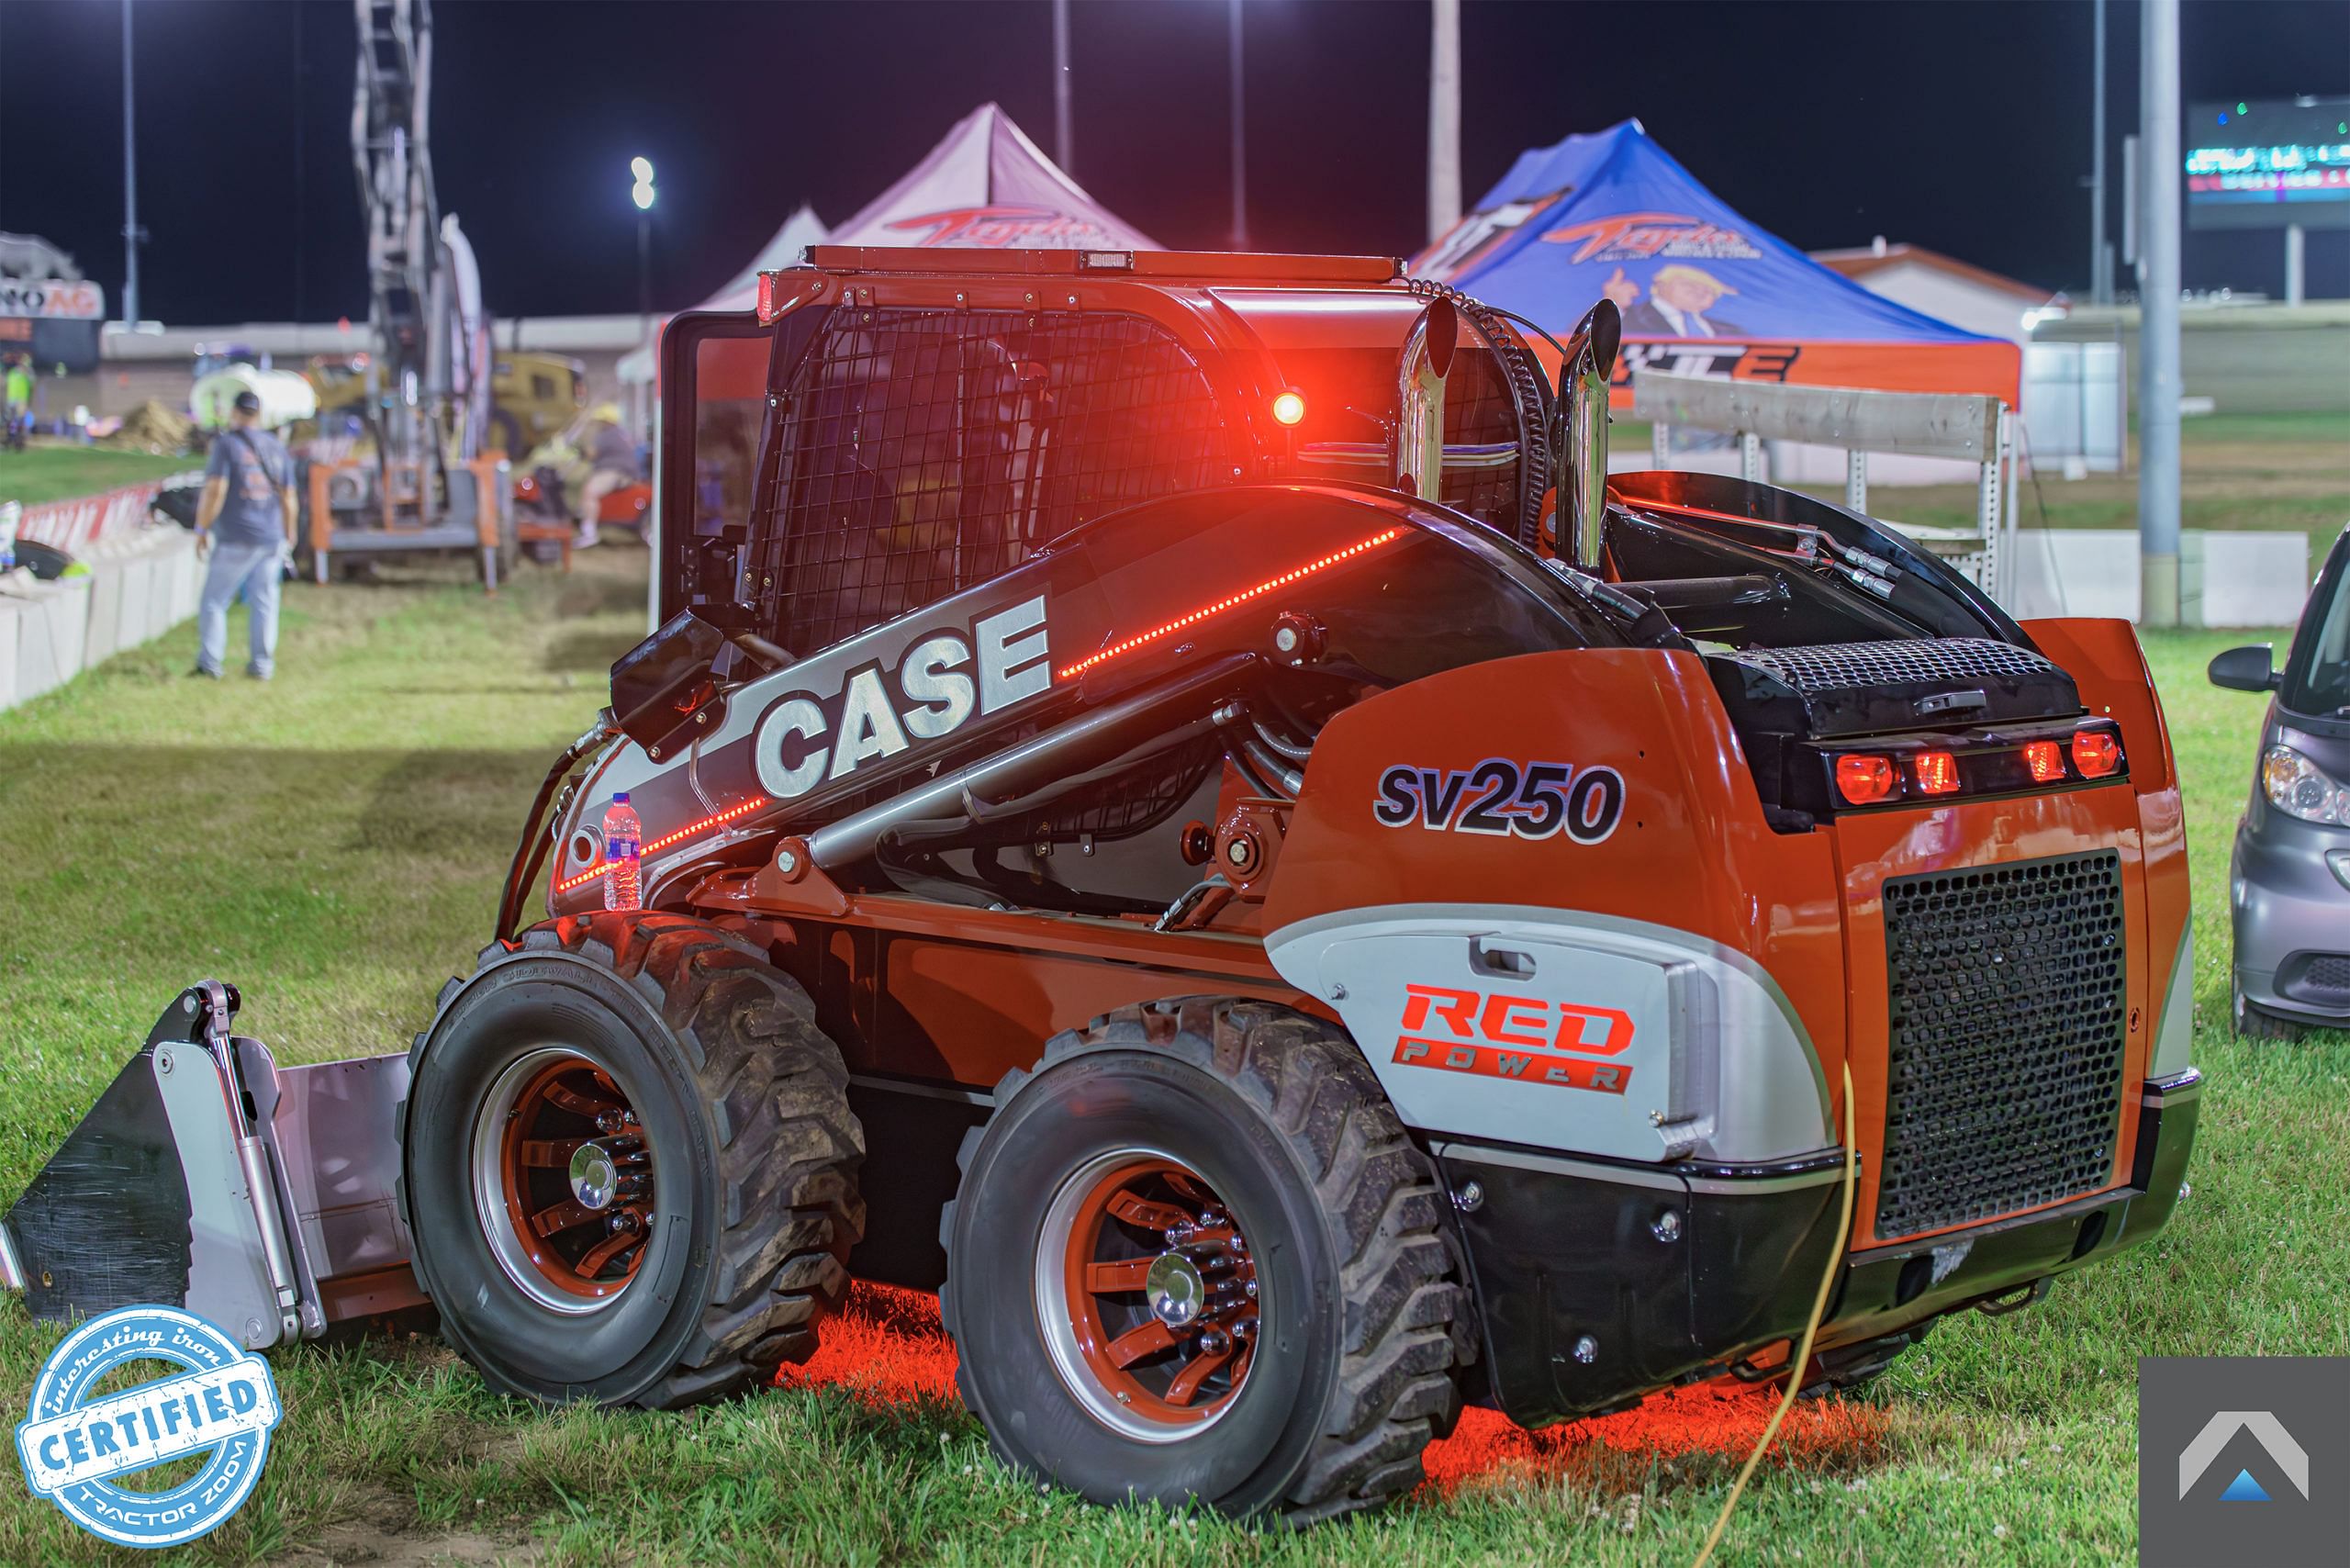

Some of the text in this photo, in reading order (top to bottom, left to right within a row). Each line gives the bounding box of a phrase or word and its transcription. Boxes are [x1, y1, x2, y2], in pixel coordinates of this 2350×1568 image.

[755, 594, 1053, 800] CASE
[1374, 758, 1625, 845] SV250
[1401, 983, 1635, 1056] RED
[1403, 1042, 1620, 1091] POWER
